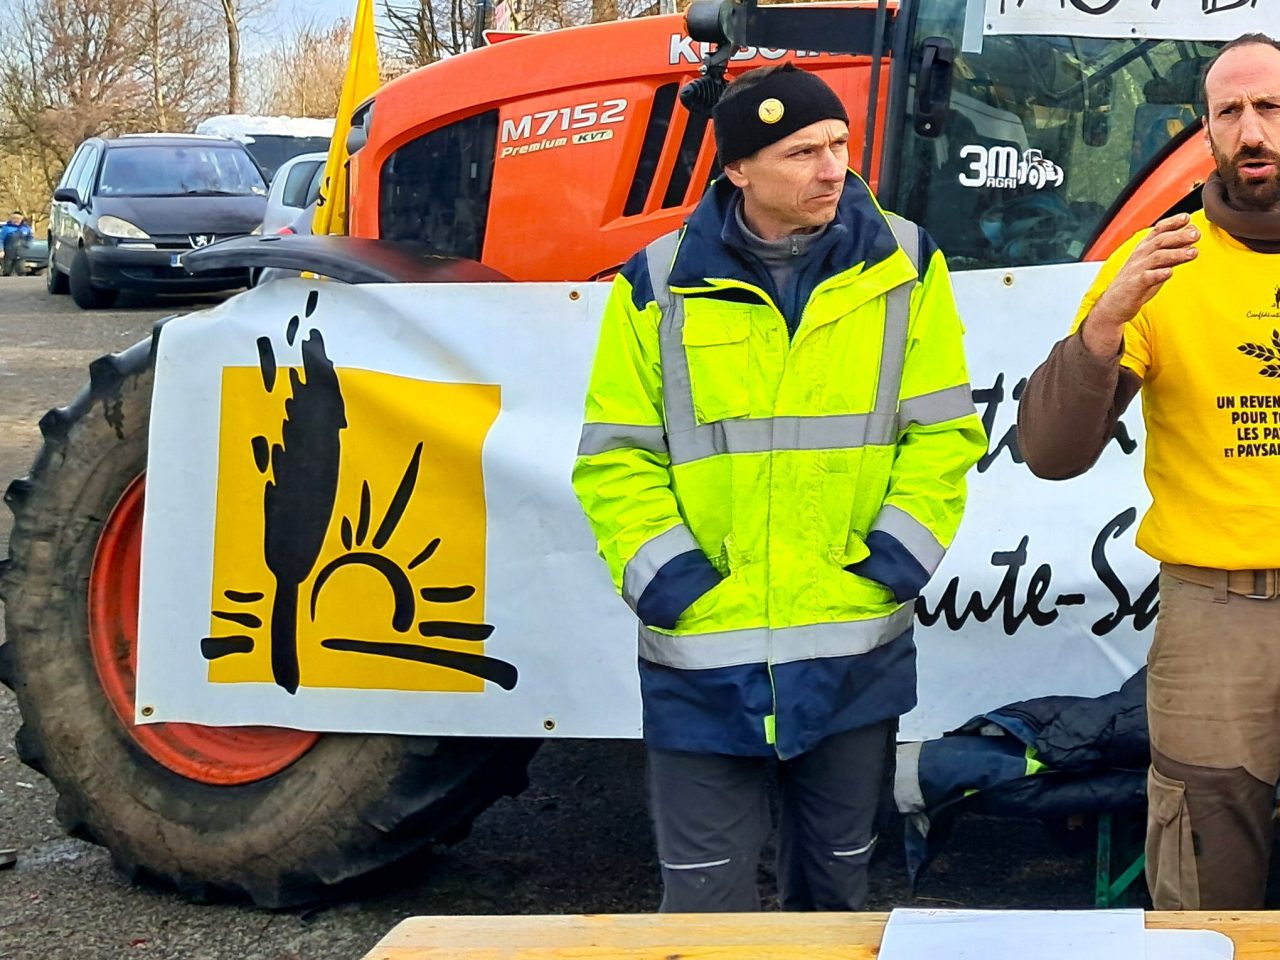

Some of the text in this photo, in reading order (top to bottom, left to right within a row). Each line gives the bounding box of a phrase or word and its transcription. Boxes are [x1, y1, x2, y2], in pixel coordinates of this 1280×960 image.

[501, 98, 628, 144] M7152
[500, 131, 608, 159] Premium KVT
[959, 144, 1018, 188] 3M
[986, 177, 1018, 189] AGRI
[1217, 396, 1235, 409] UN
[1231, 411, 1268, 424] POUR
[1237, 427, 1259, 441] LES
[1224, 448, 1235, 458] ET
